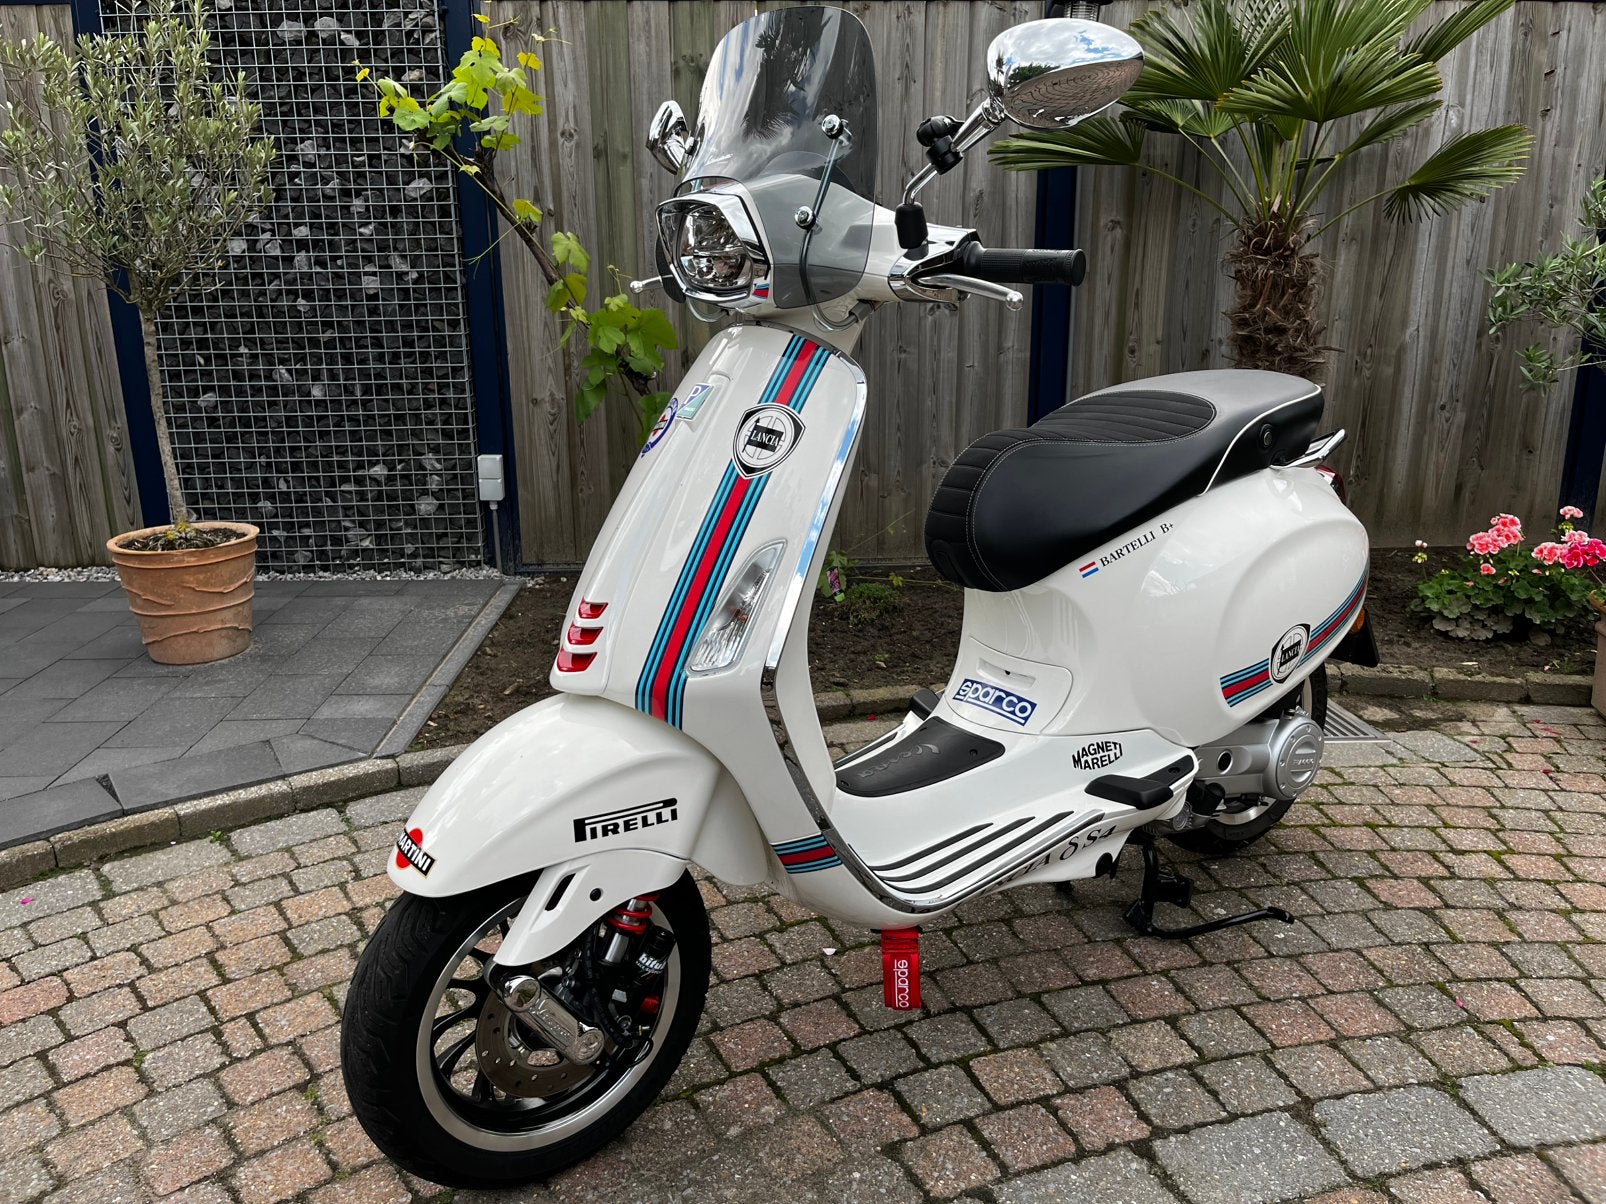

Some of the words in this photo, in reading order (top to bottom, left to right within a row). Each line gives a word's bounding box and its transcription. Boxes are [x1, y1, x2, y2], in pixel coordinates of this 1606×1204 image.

[750, 429, 780, 447] LANCIA
[1099, 530, 1156, 567] BARTELLI
[1160, 521, 1174, 535] B+
[958, 678, 1033, 719] sparco
[1072, 740, 1123, 763] MAGNETI
[1072, 752, 1123, 770] MARELLI
[573, 797, 678, 843] PIRELLI
[893, 959, 909, 1008] sparco
